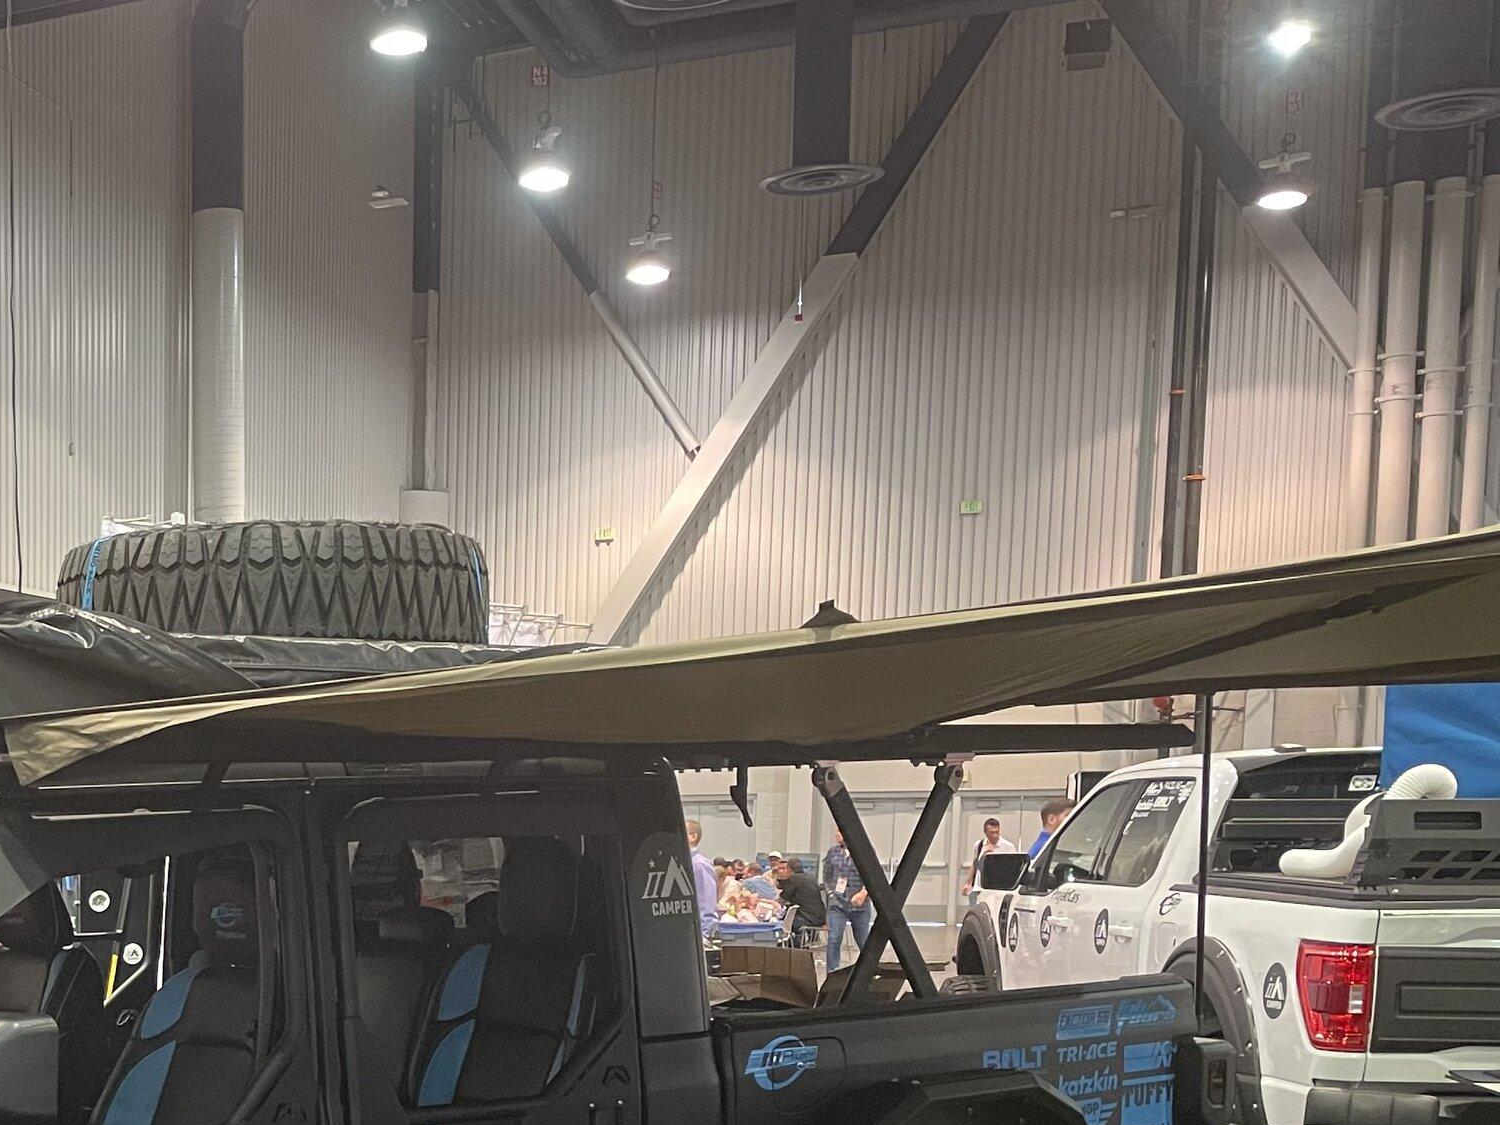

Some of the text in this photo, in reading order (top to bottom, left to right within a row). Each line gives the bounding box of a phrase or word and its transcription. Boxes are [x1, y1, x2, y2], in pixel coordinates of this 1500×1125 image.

[652, 900, 694, 916] CAMPER
[1057, 1065, 1119, 1097] katzkin
[1124, 1081, 1173, 1108] TUFFY
